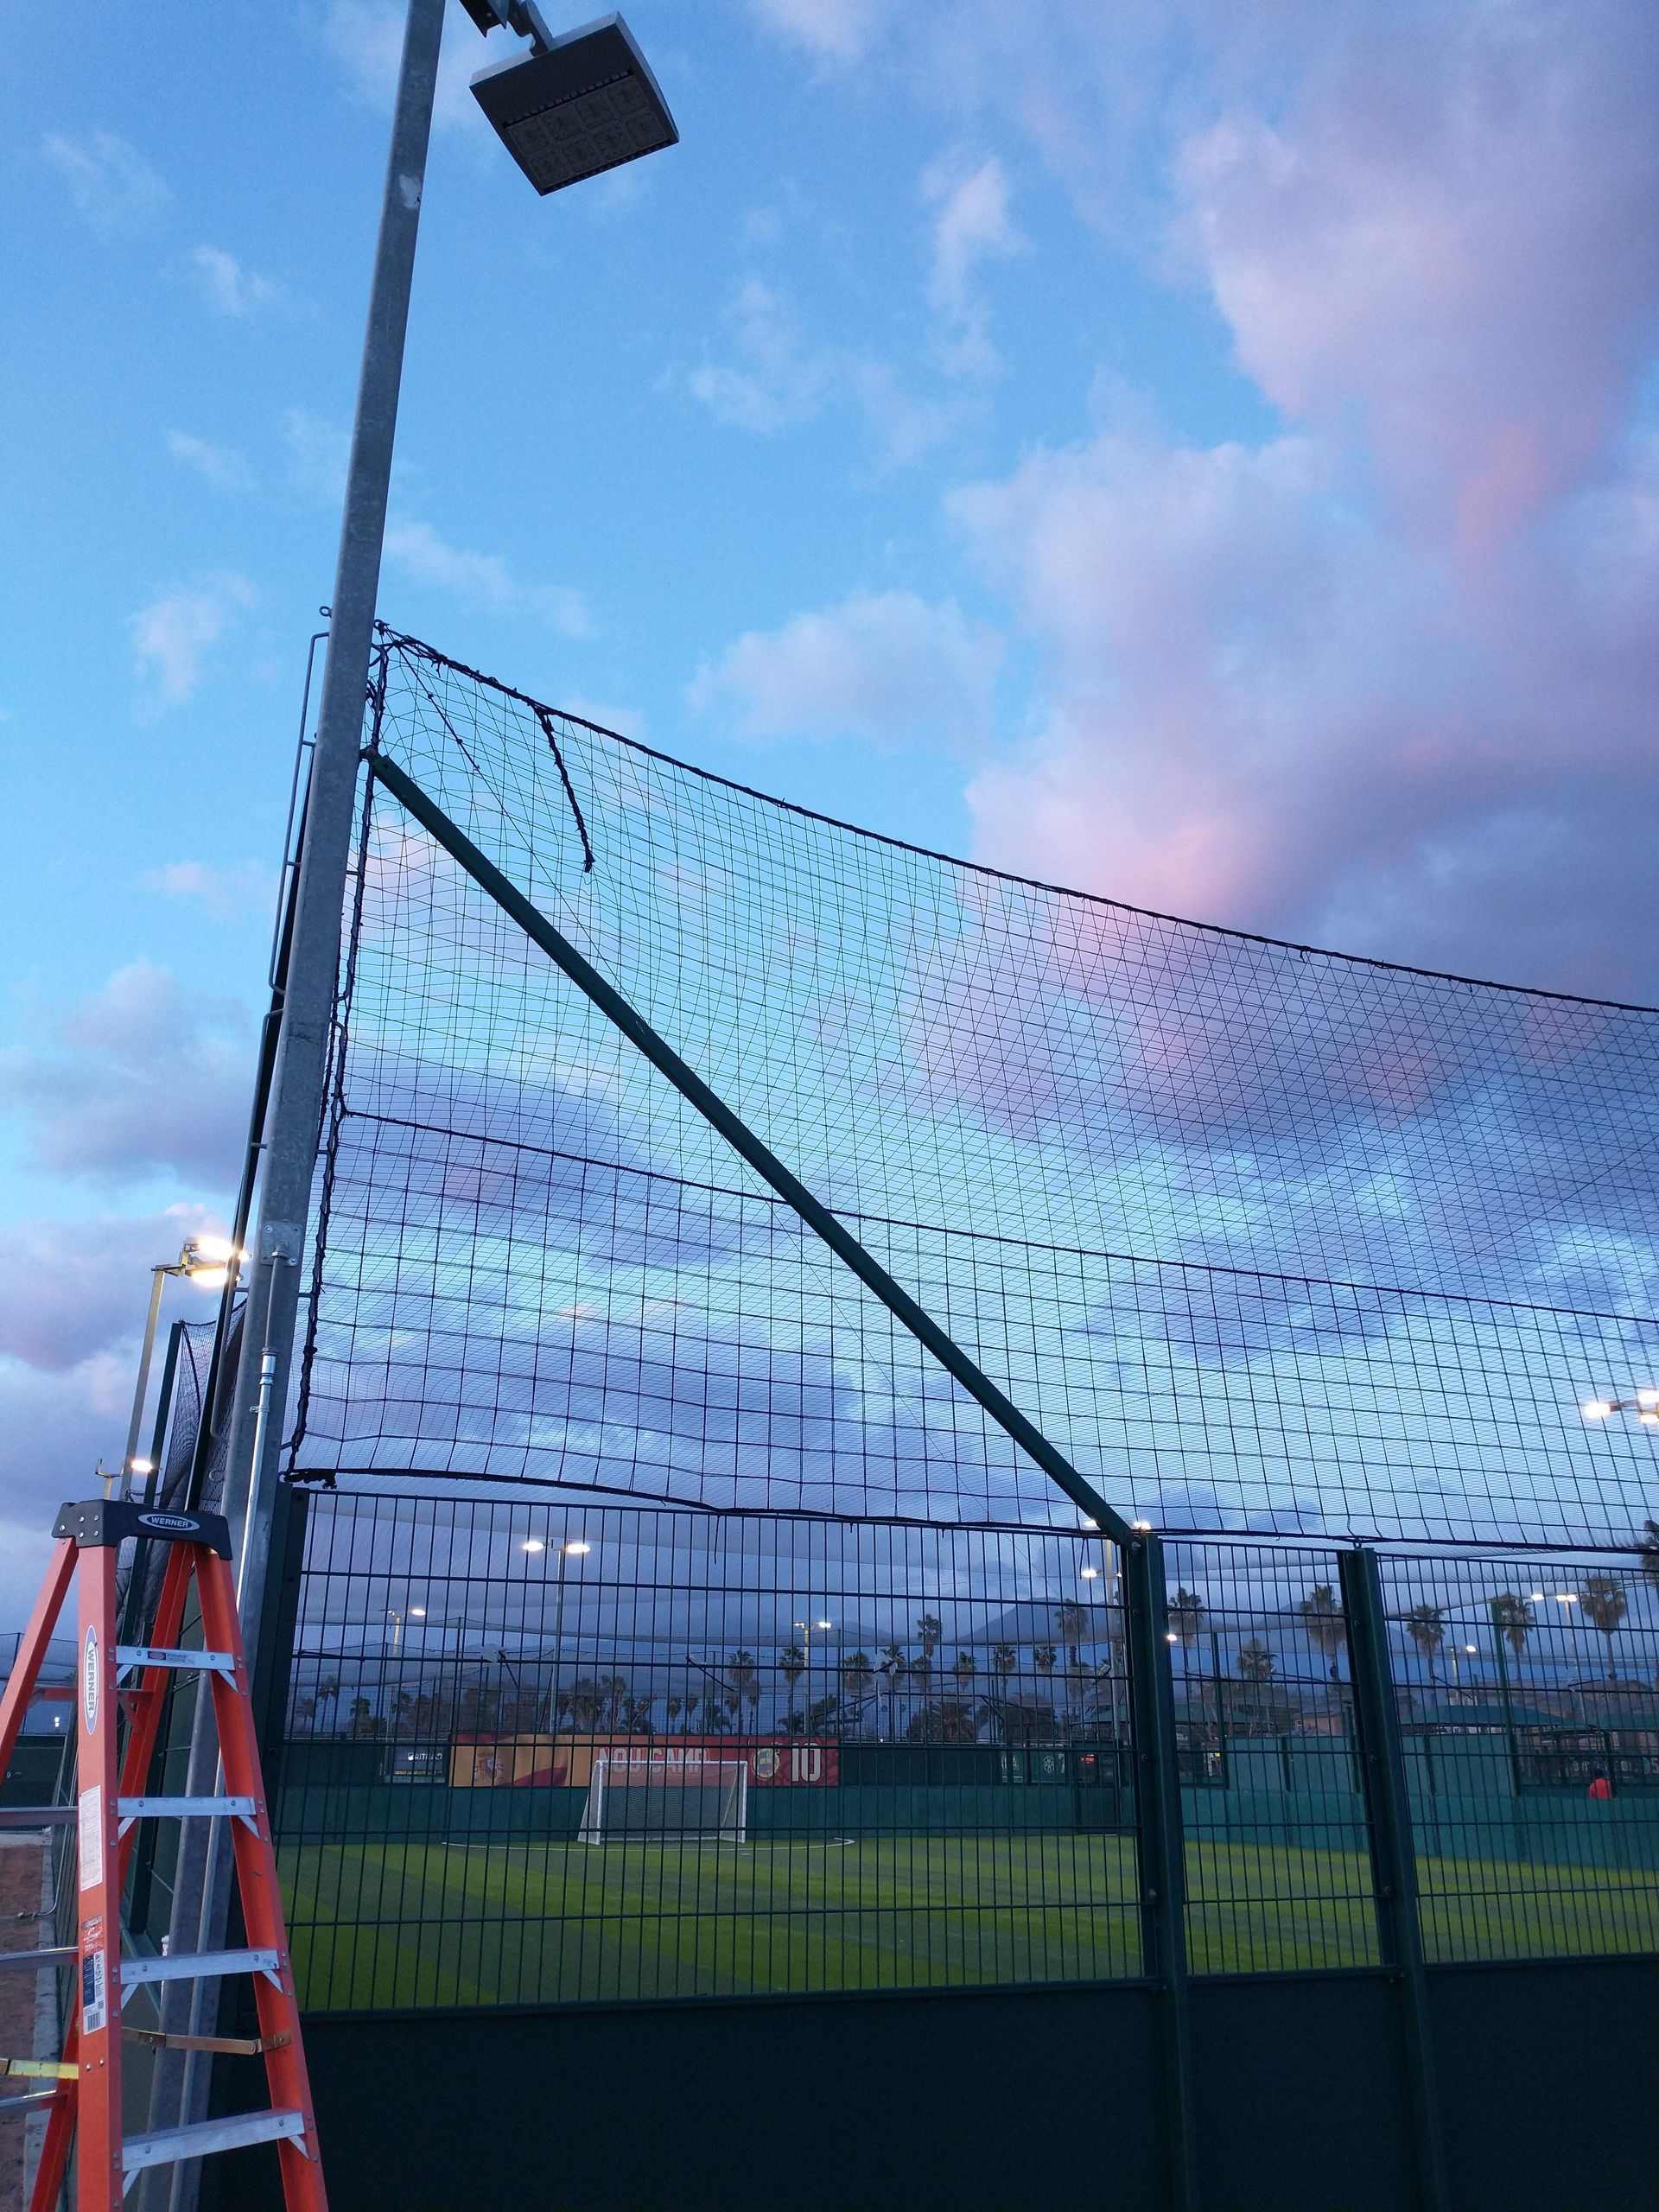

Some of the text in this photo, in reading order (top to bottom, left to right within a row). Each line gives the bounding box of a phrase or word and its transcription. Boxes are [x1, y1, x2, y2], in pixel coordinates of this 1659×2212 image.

[150, 1516, 189, 1528] WERNER
[599, 1747, 707, 1773] NOU CAMP
[791, 1742, 821, 1782] 10
